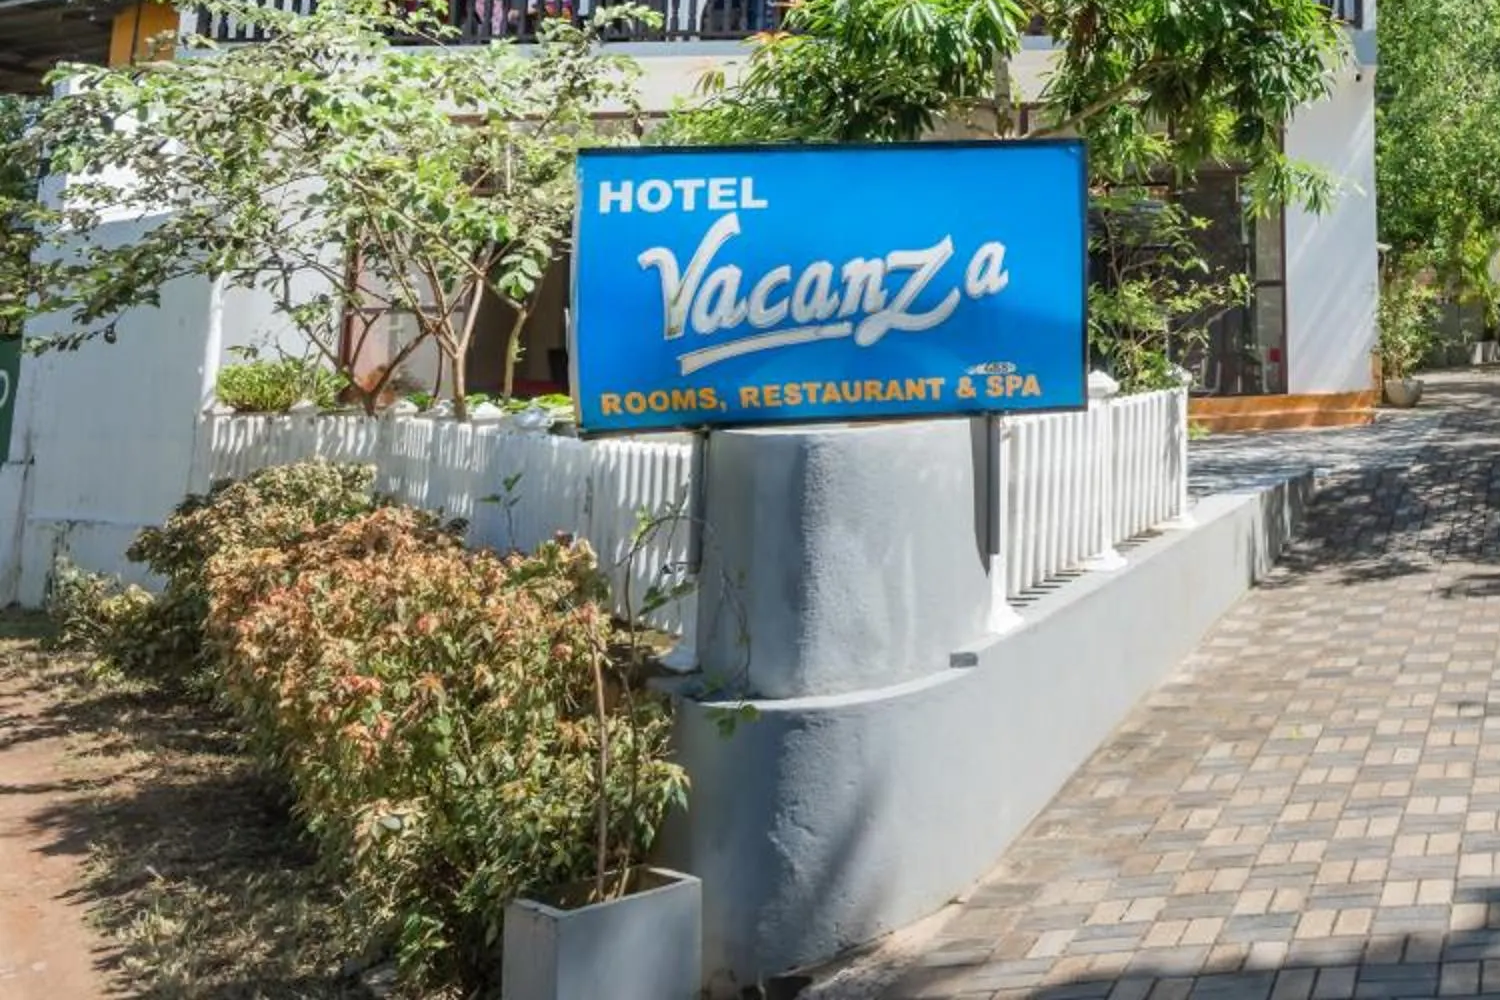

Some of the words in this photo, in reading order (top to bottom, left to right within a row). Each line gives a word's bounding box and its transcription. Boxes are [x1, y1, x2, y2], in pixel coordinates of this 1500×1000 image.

[599, 176, 768, 214] HOTEL
[600, 386, 727, 416] ROOMS,
[738, 376, 946, 409] RESTAURANT
[956, 375, 977, 399] &
[986, 372, 1042, 398] SPA
